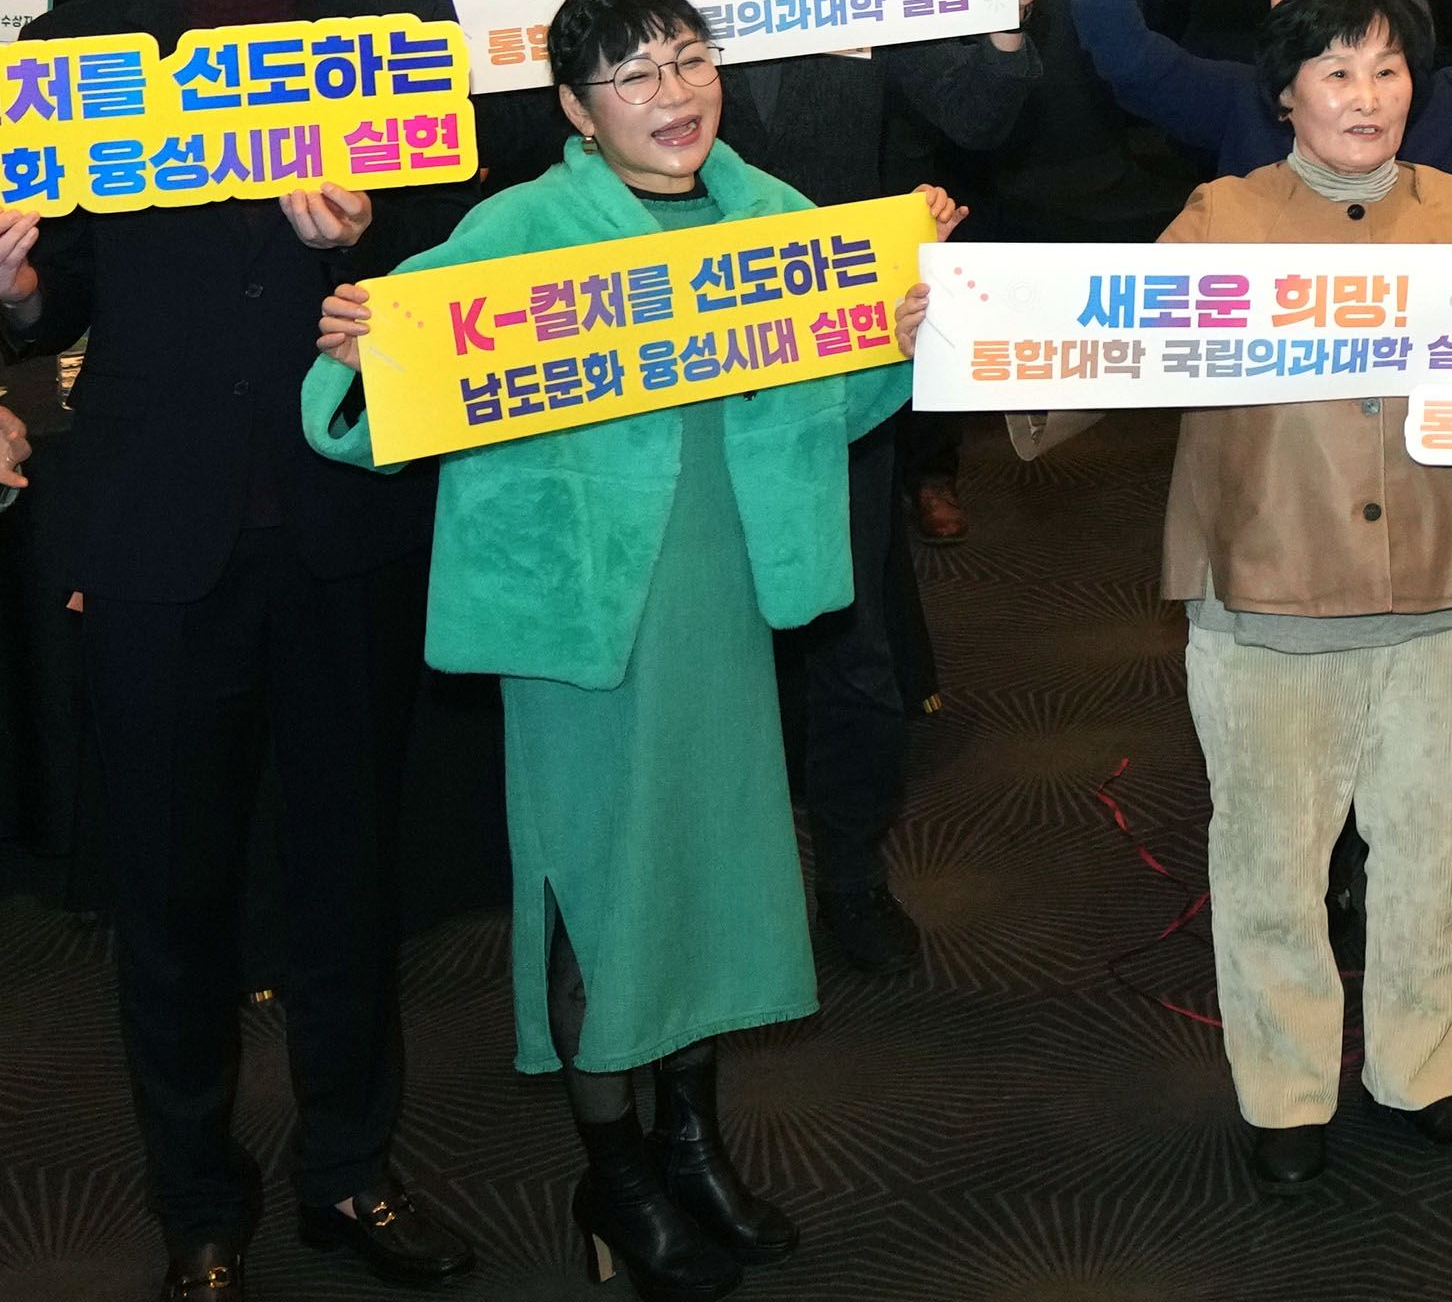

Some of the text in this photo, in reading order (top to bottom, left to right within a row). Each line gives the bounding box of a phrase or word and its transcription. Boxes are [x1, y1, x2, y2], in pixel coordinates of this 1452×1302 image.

[0, 50, 147, 125] 처를
[172, 30, 454, 112] 선도하는
[88, 112, 462, 198] 융성시대 실현
[449, 235, 879, 355] K-컬처를 선도하는
[1077, 274, 1410, 329] 새로운 희망!
[461, 300, 892, 426] 남도문화 융성시대 실현
[970, 339, 1146, 381] 통합대학
[1161, 335, 1414, 379] 국립의과대학
